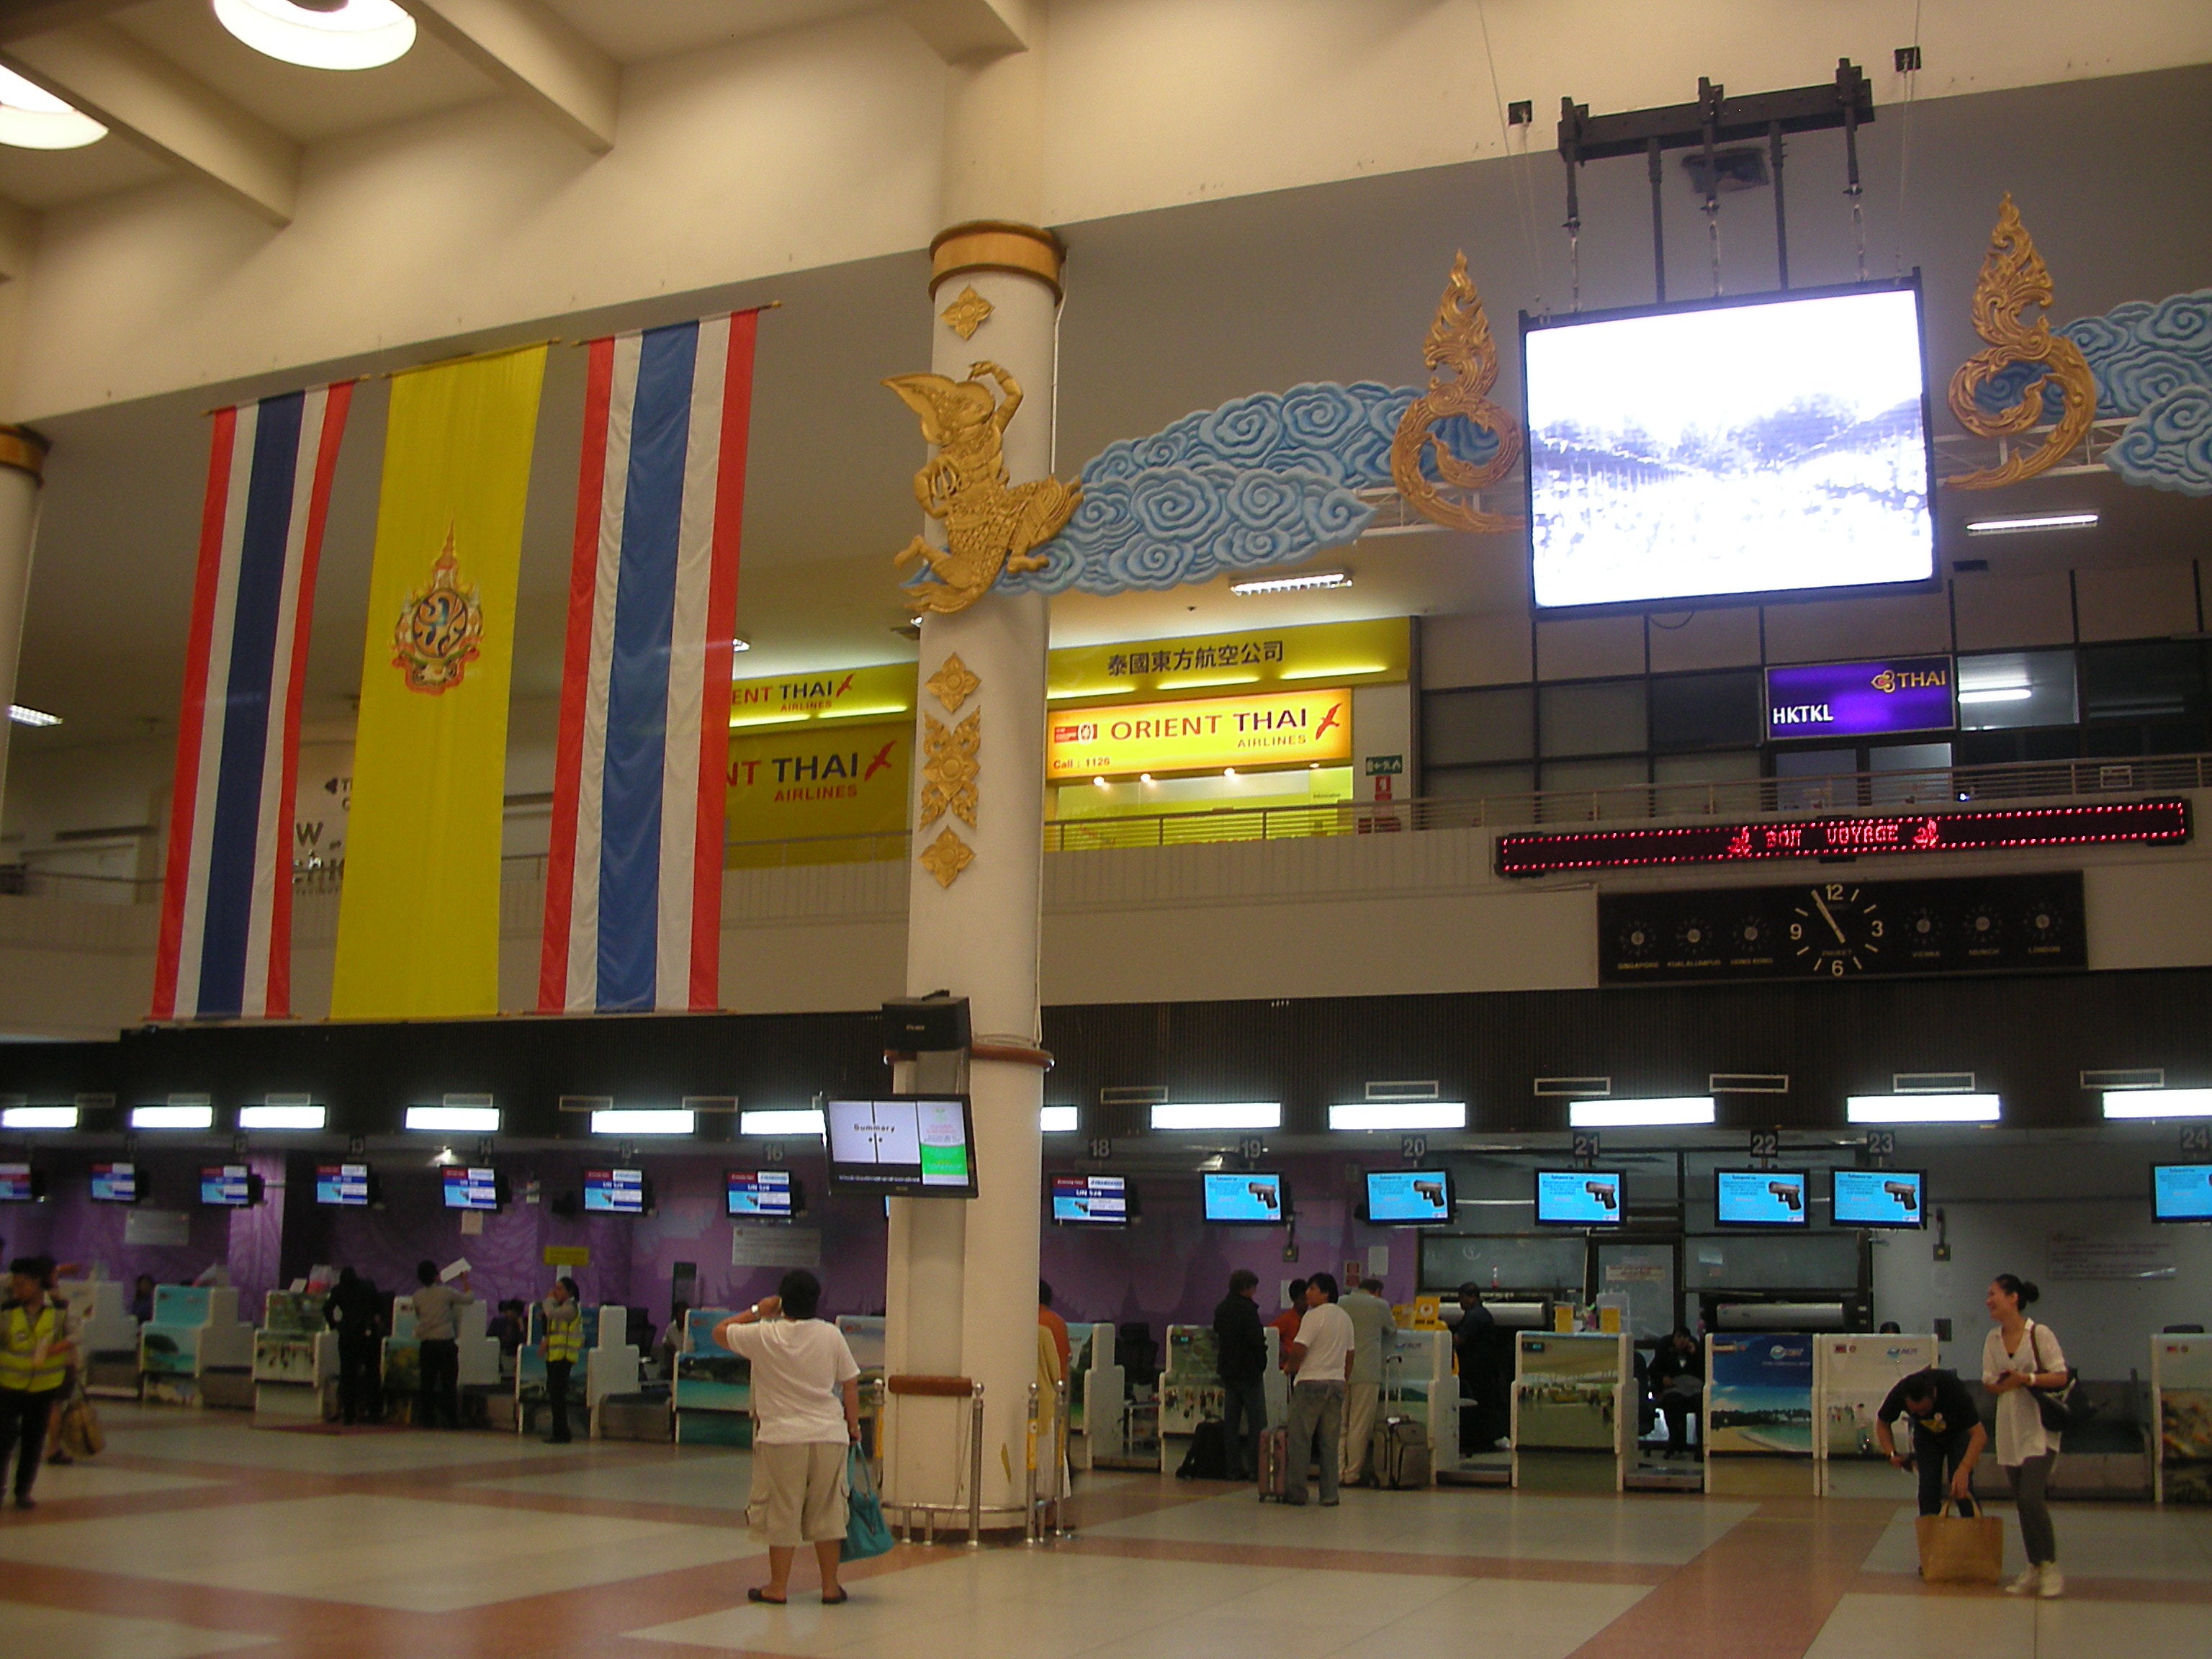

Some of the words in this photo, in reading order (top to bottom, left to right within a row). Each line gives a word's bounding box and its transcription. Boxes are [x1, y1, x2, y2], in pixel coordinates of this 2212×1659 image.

[1107, 640, 1283, 676] 泰國東方航空公司
[1897, 670, 1946, 688] THAI
[731, 686, 773, 705] ENT
[780, 680, 832, 700] THAI
[781, 701, 832, 712] AIRLINES
[1772, 704, 1834, 725] HKTKL
[1111, 714, 1223, 740] ORIENT
[1232, 708, 1306, 732] THAI
[1238, 734, 1306, 748] AIRLINES
[772, 752, 858, 783] THAI
[1053, 759, 1073, 770] Call
[1086, 757, 1110, 768] 1126
[774, 783, 858, 802] AIRLINES
[1766, 830, 1802, 848] BON
[1827, 824, 1899, 845] VOYAGE
[1825, 884, 1843, 902] 12
[1789, 923, 1802, 940] 9
[1871, 920, 1884, 938] 3
[1831, 960, 1844, 977] 6
[1089, 1138, 1110, 1158] 18
[1404, 1138, 1424, 1157] 20
[1575, 1136, 1598, 1156] 21
[1752, 1134, 1777, 1155] 22
[1869, 1133, 1894, 1154] 23
[2182, 1128, 2208, 1149] 24
[1241, 1140, 1261, 1159] 19
